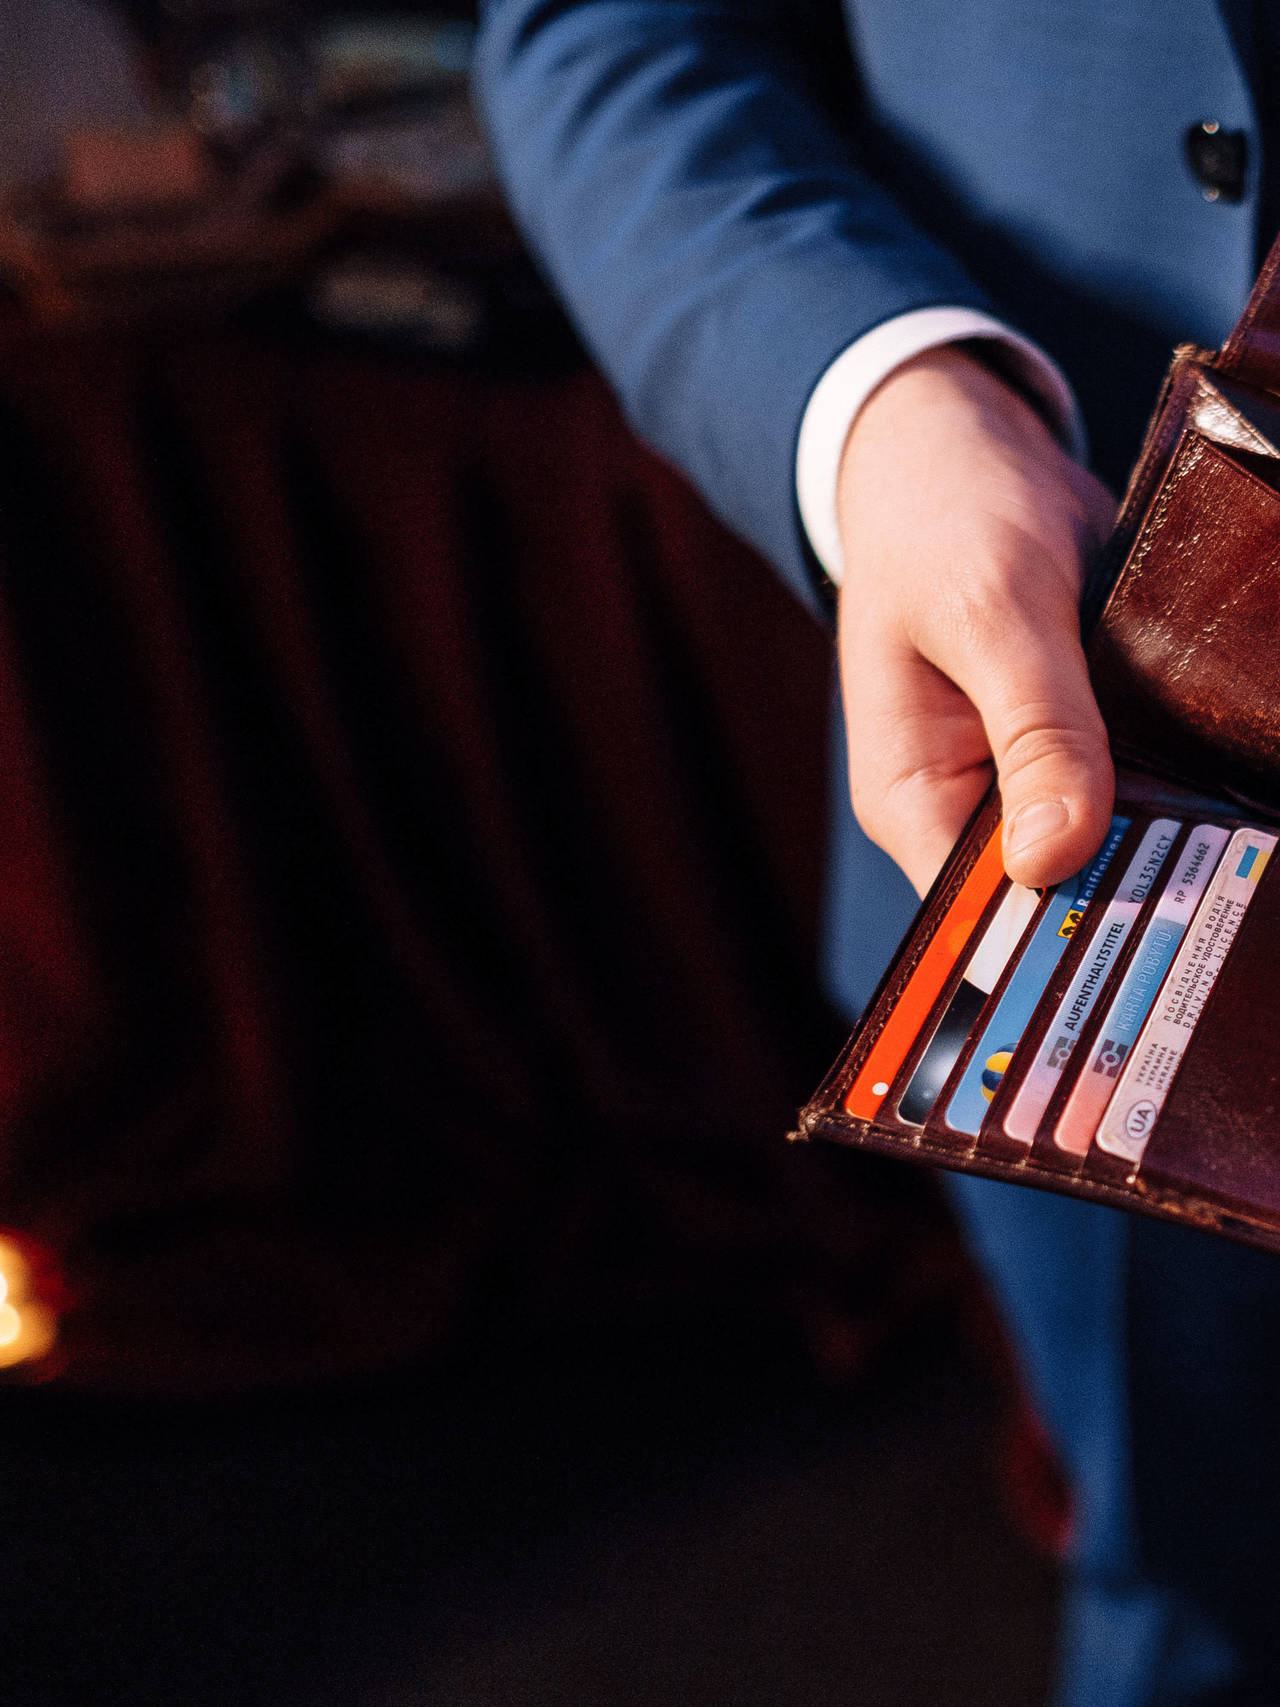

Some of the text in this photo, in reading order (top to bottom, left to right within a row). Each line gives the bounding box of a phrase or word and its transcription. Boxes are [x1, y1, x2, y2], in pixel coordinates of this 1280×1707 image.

[1077, 834, 1122, 907] Raiffeisen
[1174, 842, 1210, 904] RP 5364662
[1064, 922, 1126, 1032] AUFENTHALTSTITEL
[1115, 928, 1172, 1033] KARTA POBYTU
[1163, 937, 1207, 1021] ПОСВІДЧЕННЯ
[1204, 895, 1226, 930] ВОДІЯ
[1173, 962, 1206, 1025] ВОДИТЕЛЬСКОЕ
[1201, 899, 1235, 962] УДОСТОВЕРЕНИЕ
[1183, 970, 1214, 1029] DRIVING
[1213, 902, 1245, 959] LICENCE
[1129, 1108, 1153, 1133] UA
[1155, 1049, 1178, 1090] UKRAINE
